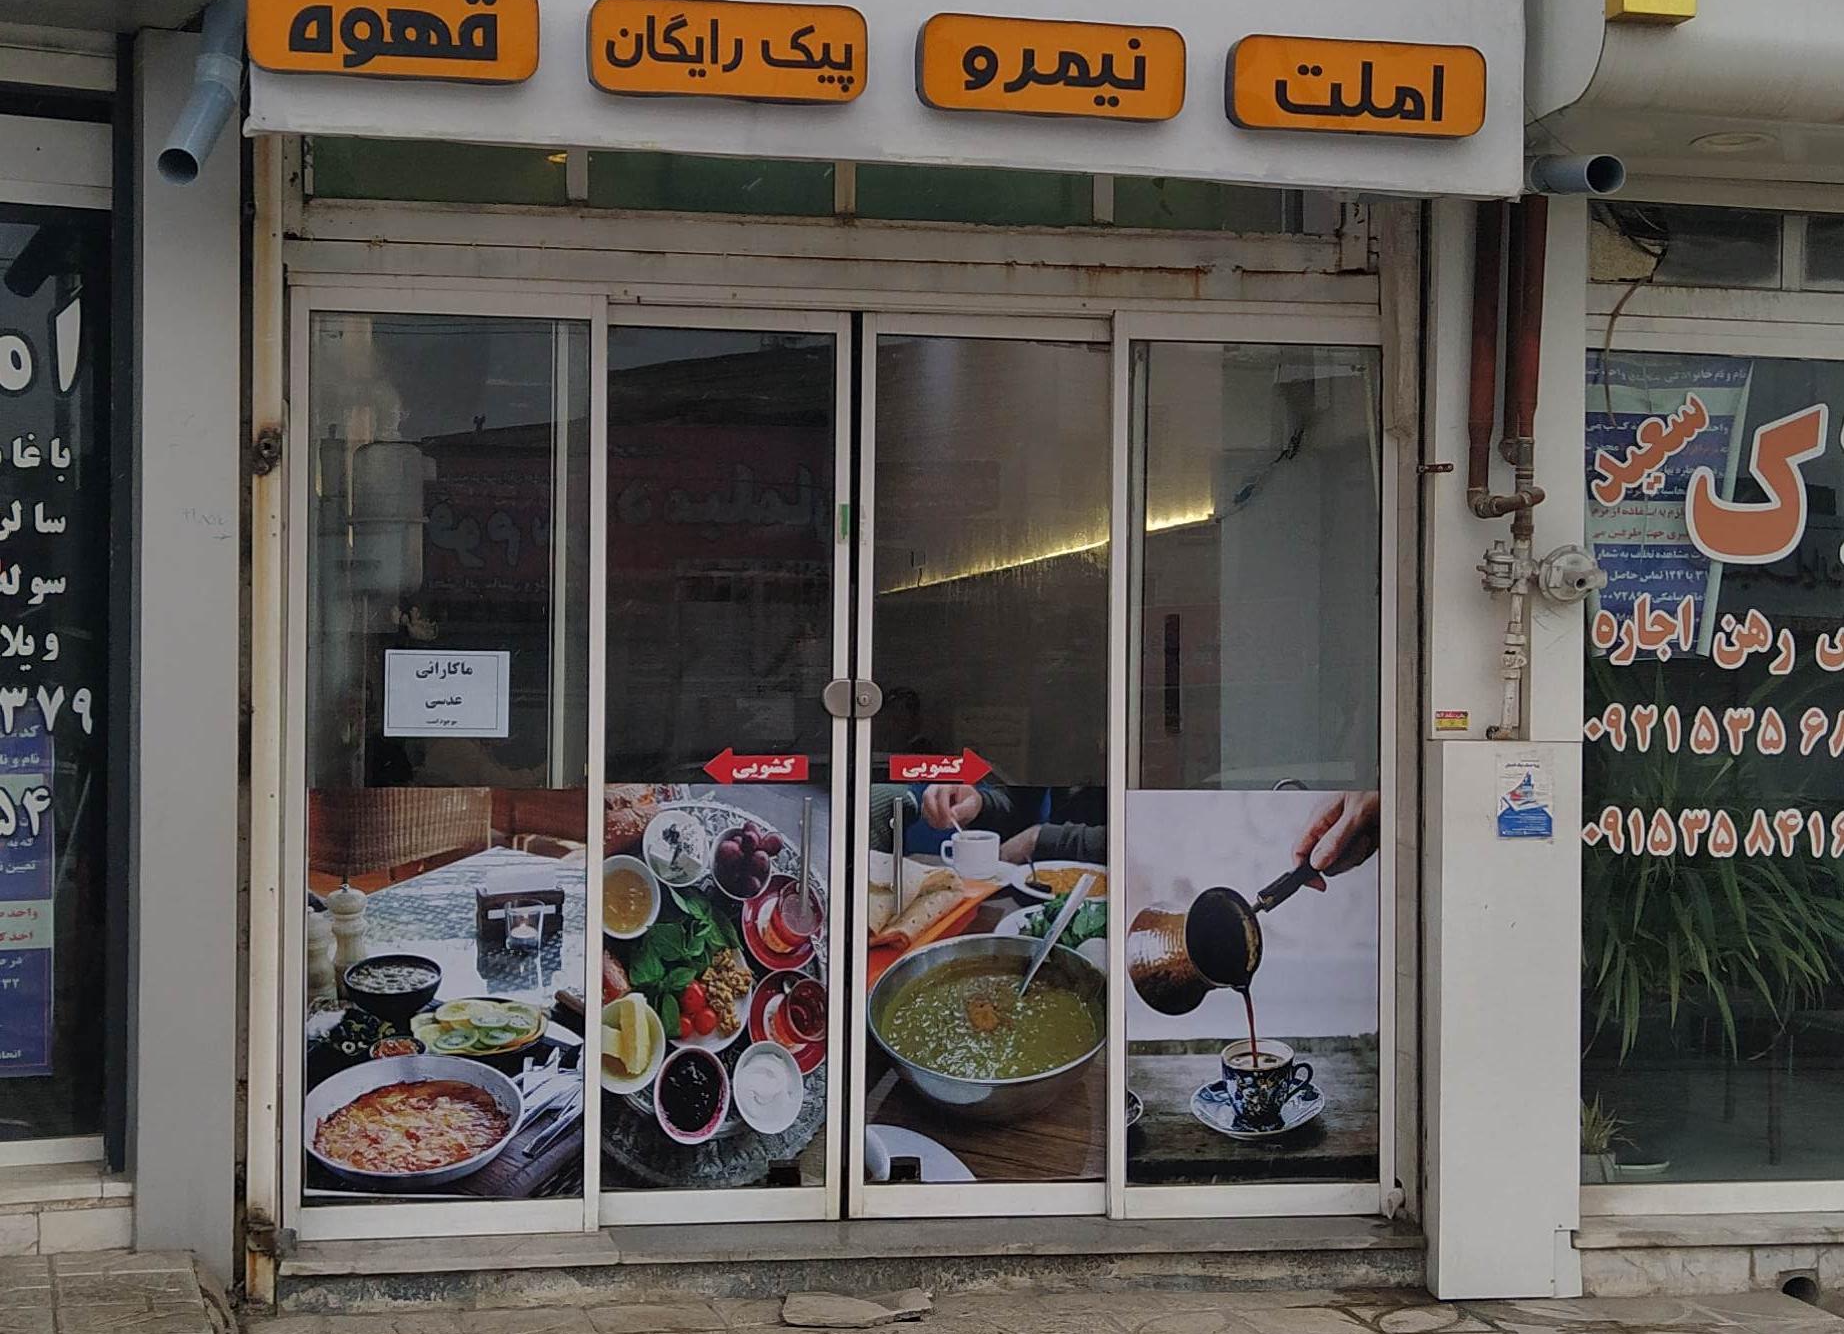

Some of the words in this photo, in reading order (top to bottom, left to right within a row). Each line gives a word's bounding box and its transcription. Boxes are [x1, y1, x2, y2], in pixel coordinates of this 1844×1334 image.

[605, 13, 743, 77] رایگان
[762, 25, 855, 93] پیک
[962, 38, 1146, 107] نیمرو
[1275, 61, 1445, 121] املت
[1591, 392, 1709, 506] سعید
[1592, 593, 1695, 666] اجاره
[1713, 609, 1795, 675] رهن
[415, 660, 474, 680] ماکارانی
[424, 695, 463, 710] عدسی
[732, 758, 795, 780] کشویی
[902, 758, 964, 779] کشویی
